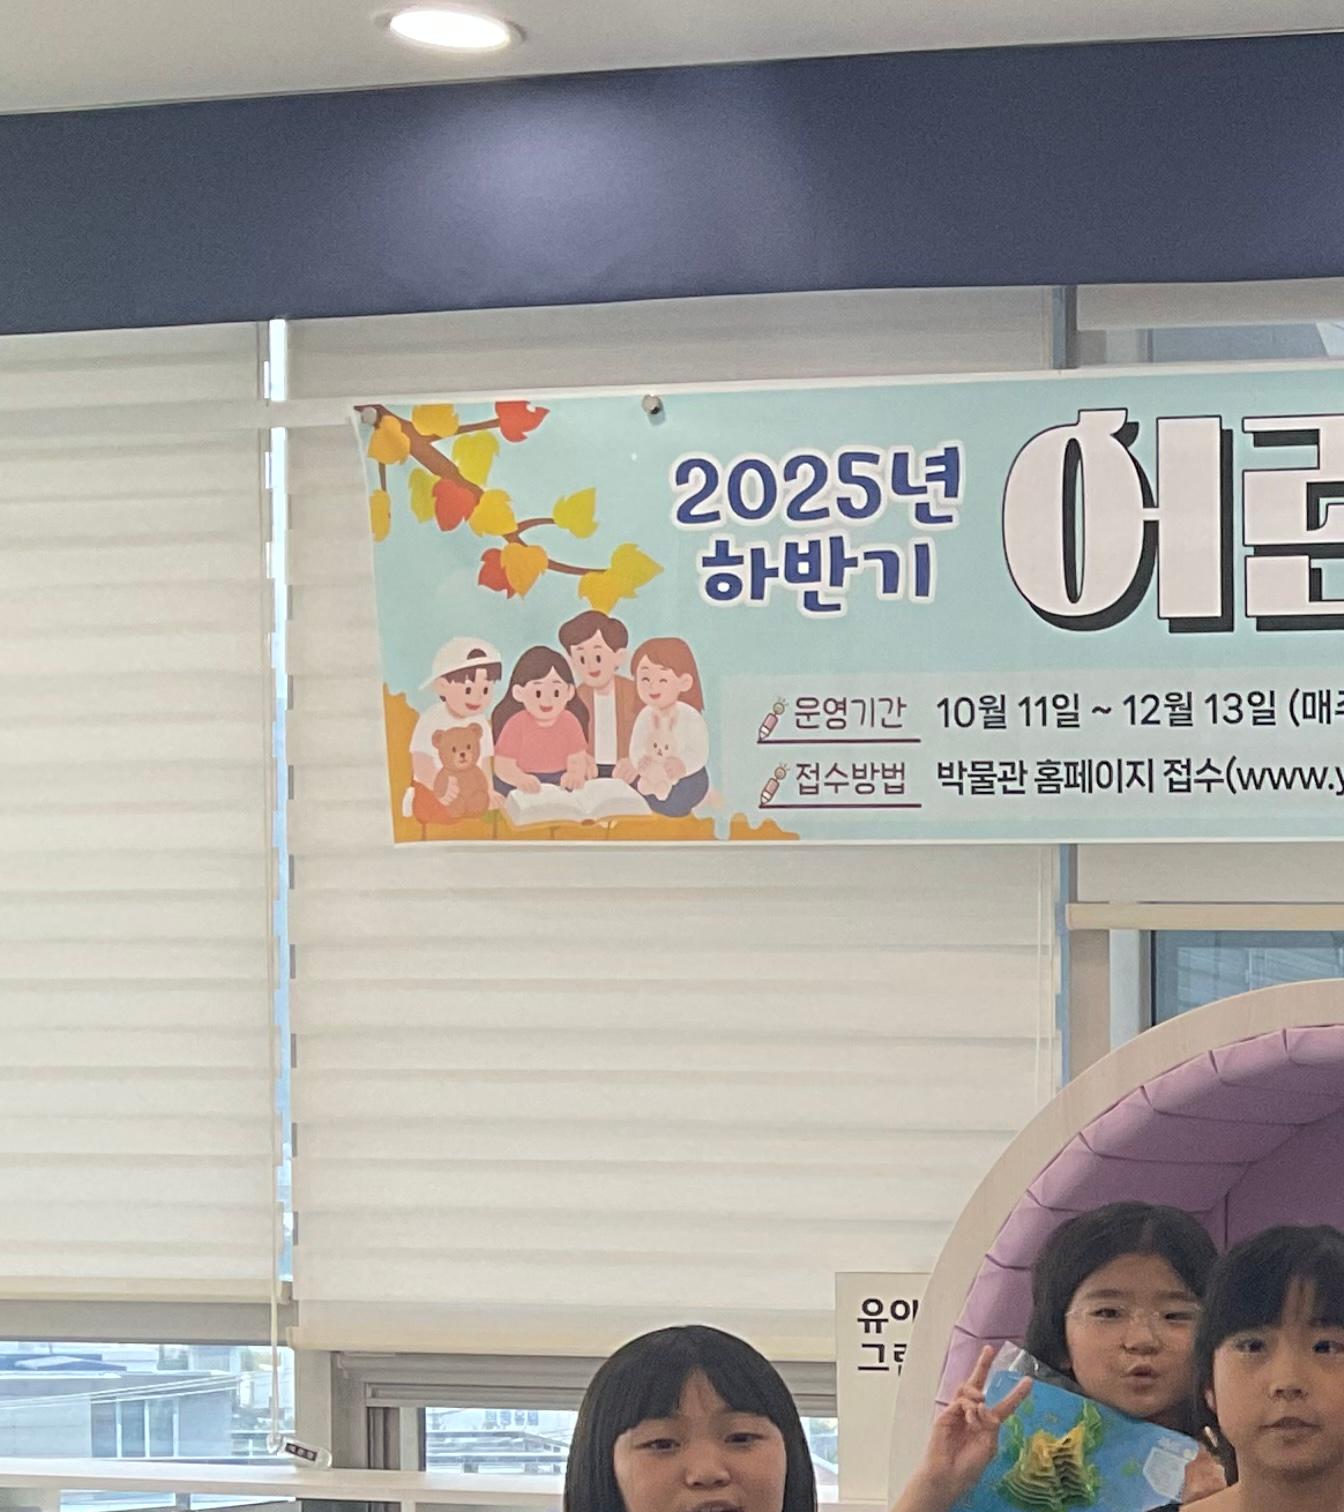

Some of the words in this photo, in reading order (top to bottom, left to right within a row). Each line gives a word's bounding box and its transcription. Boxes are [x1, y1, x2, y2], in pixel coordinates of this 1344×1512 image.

[675, 446, 960, 525] 2025년
[701, 535, 931, 612] 하반기
[794, 696, 907, 730] 운영기간
[936, 694, 1007, 730] 10월
[1018, 693, 1081, 729] 11일
[1123, 691, 1194, 727] 12월
[1204, 690, 1277, 726] 13일
[796, 762, 905, 796] 접수방법
[937, 759, 1028, 796] 박물관
[1034, 758, 1154, 794] 홈페이지
